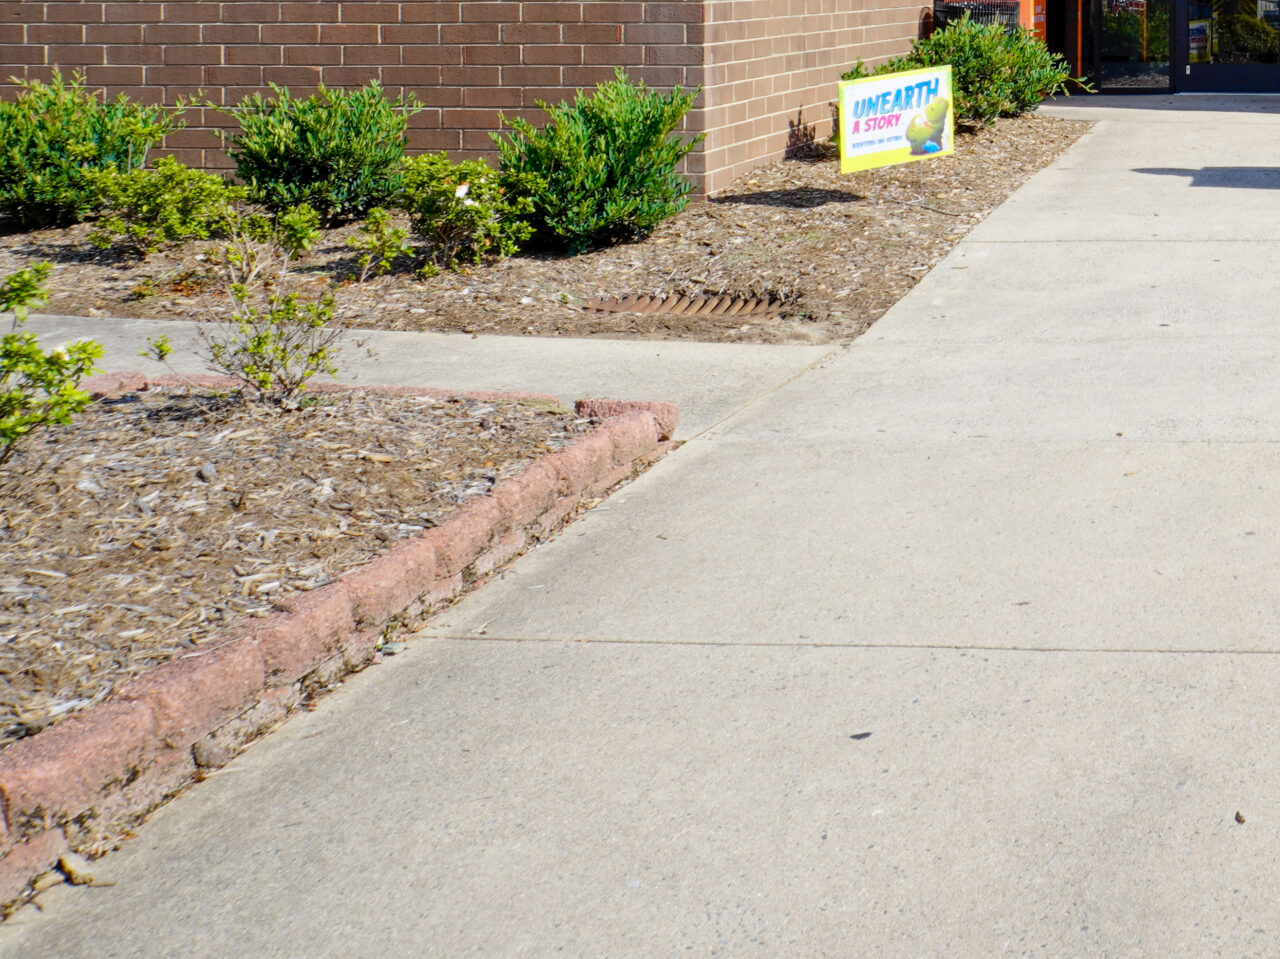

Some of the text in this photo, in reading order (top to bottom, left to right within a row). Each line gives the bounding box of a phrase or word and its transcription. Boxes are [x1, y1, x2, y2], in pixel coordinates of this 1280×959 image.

[852, 77, 940, 119] UNEARTH
[852, 113, 902, 135] A STORY
